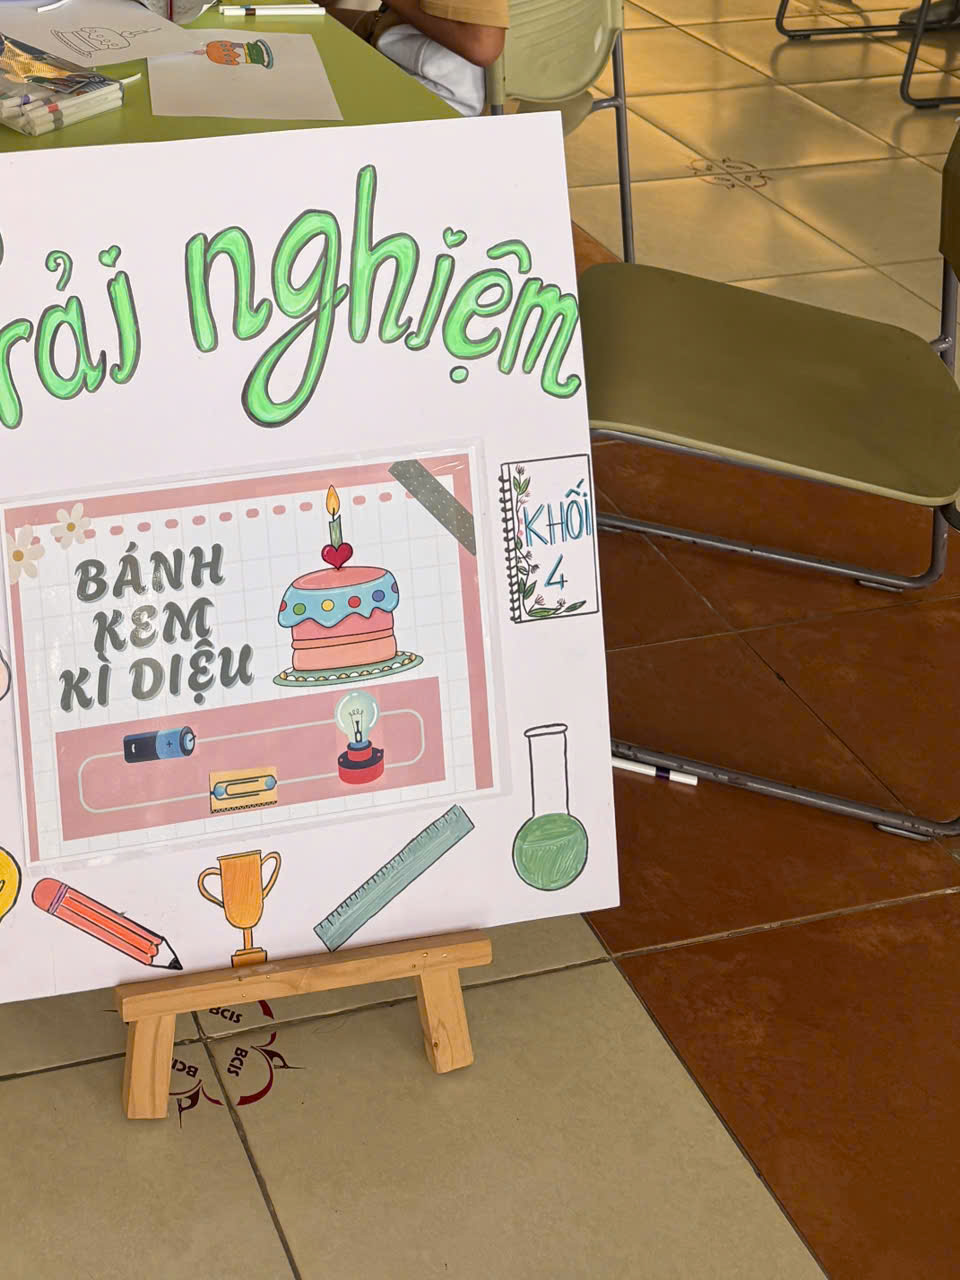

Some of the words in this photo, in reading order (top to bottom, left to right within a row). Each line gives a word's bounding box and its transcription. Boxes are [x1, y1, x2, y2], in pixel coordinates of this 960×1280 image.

[183, 164, 584, 430] nghiệm
[523, 477, 592, 548] KHỐI
[75, 541, 226, 604] BÁNH
[543, 553, 569, 591] 4
[93, 596, 214, 655] KEM
[59, 652, 113, 713] KÌ
[130, 638, 255, 705] DIỆU
[171, 1056, 199, 1078] BCI
[226, 1046, 249, 1077] BCIS
